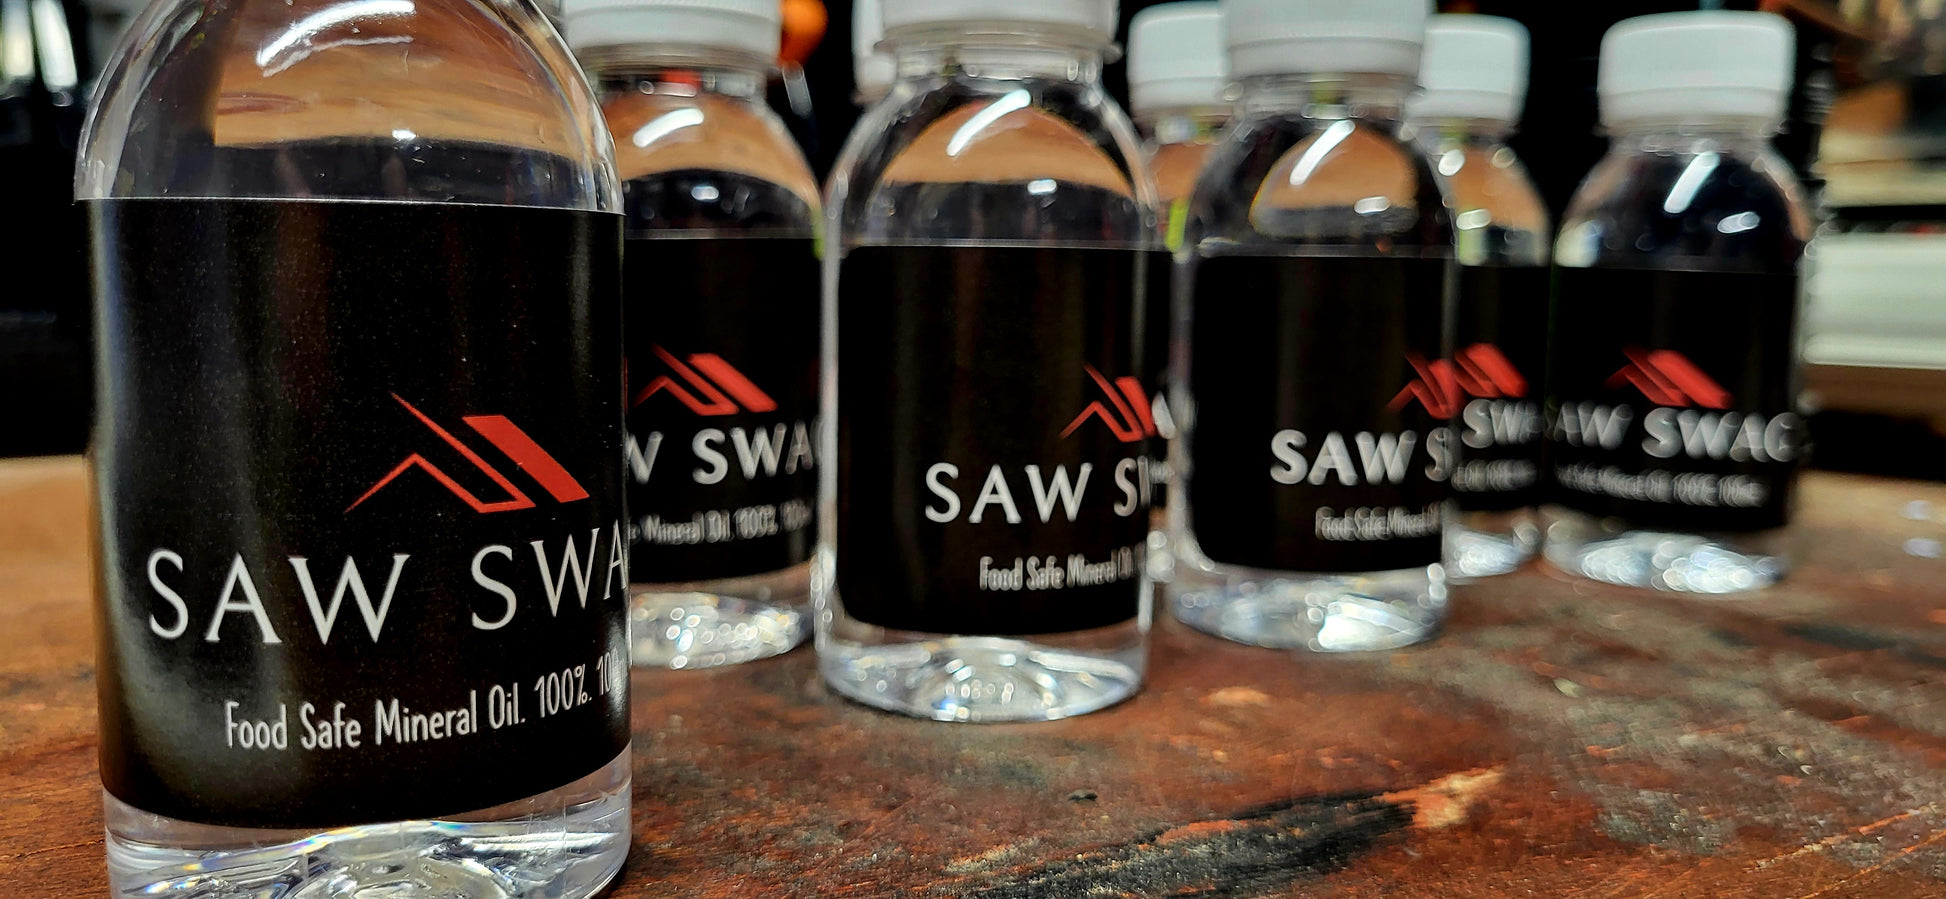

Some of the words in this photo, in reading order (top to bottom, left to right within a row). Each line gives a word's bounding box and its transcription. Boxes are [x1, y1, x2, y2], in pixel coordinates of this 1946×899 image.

[692, 421, 820, 485] SWA
[1270, 429, 1417, 486] SAW
[1425, 427, 1459, 482] S
[925, 462, 1093, 524] SAW
[147, 548, 411, 645] SAW
[979, 556, 1023, 591] Food
[1026, 555, 1065, 591] Safe
[225, 701, 288, 750] Food
[300, 701, 361, 750] Safe
[374, 689, 478, 746] Mineral
[488, 682, 526, 729] Oil.
[534, 664, 592, 718] 100%.
